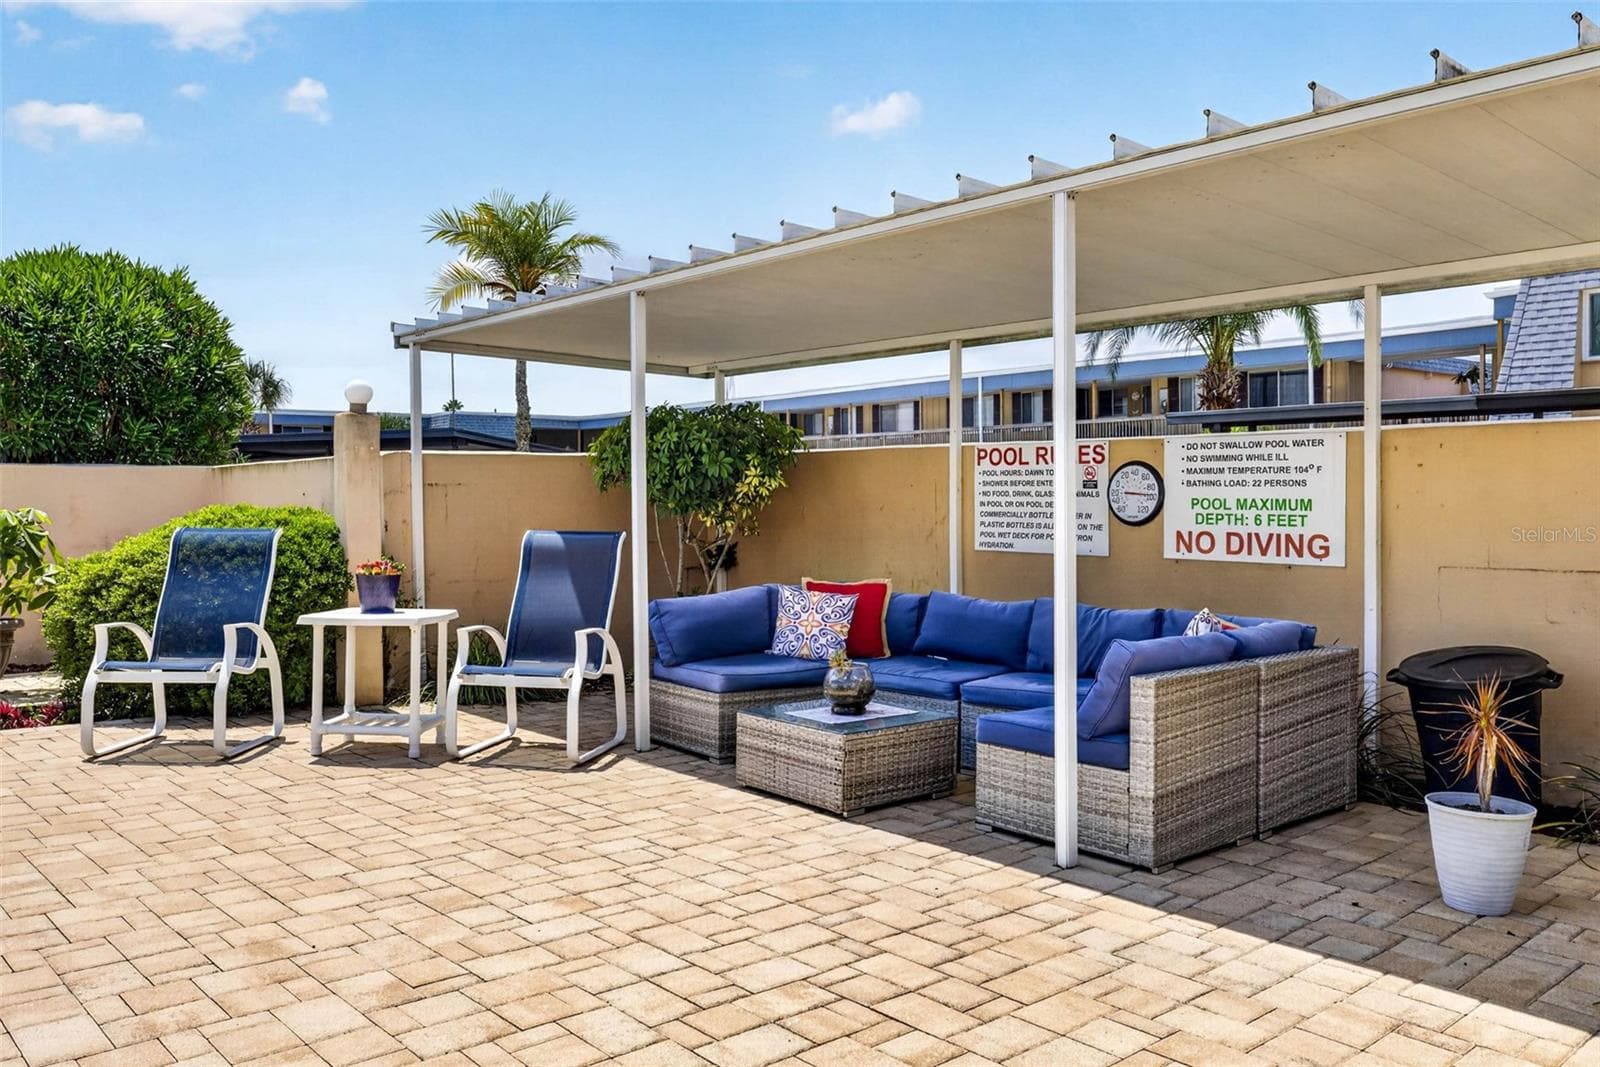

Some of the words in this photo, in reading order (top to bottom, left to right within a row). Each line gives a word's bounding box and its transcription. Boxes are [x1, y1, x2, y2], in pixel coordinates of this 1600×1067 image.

[1187, 442, 1198, 450] DO
[1220, 441, 1262, 449] SWALLOW
[1265, 440, 1289, 448] POOL
[1292, 439, 1324, 447] WATER
[977, 447, 1029, 466] POOL
[1035, 444, 1105, 465] RES
[1200, 454, 1243, 462] SWIMMING
[1228, 466, 1291, 474] TEMPERATURE
[1191, 498, 1232, 510] POOL
[1236, 498, 1312, 511] MAXIMUM
[1195, 513, 1249, 525] DEPTH:
[1254, 514, 1262, 526] 6
[1268, 514, 1308, 527] FEET
[1176, 531, 1215, 554] NO
[1226, 532, 1330, 559] DIVING
